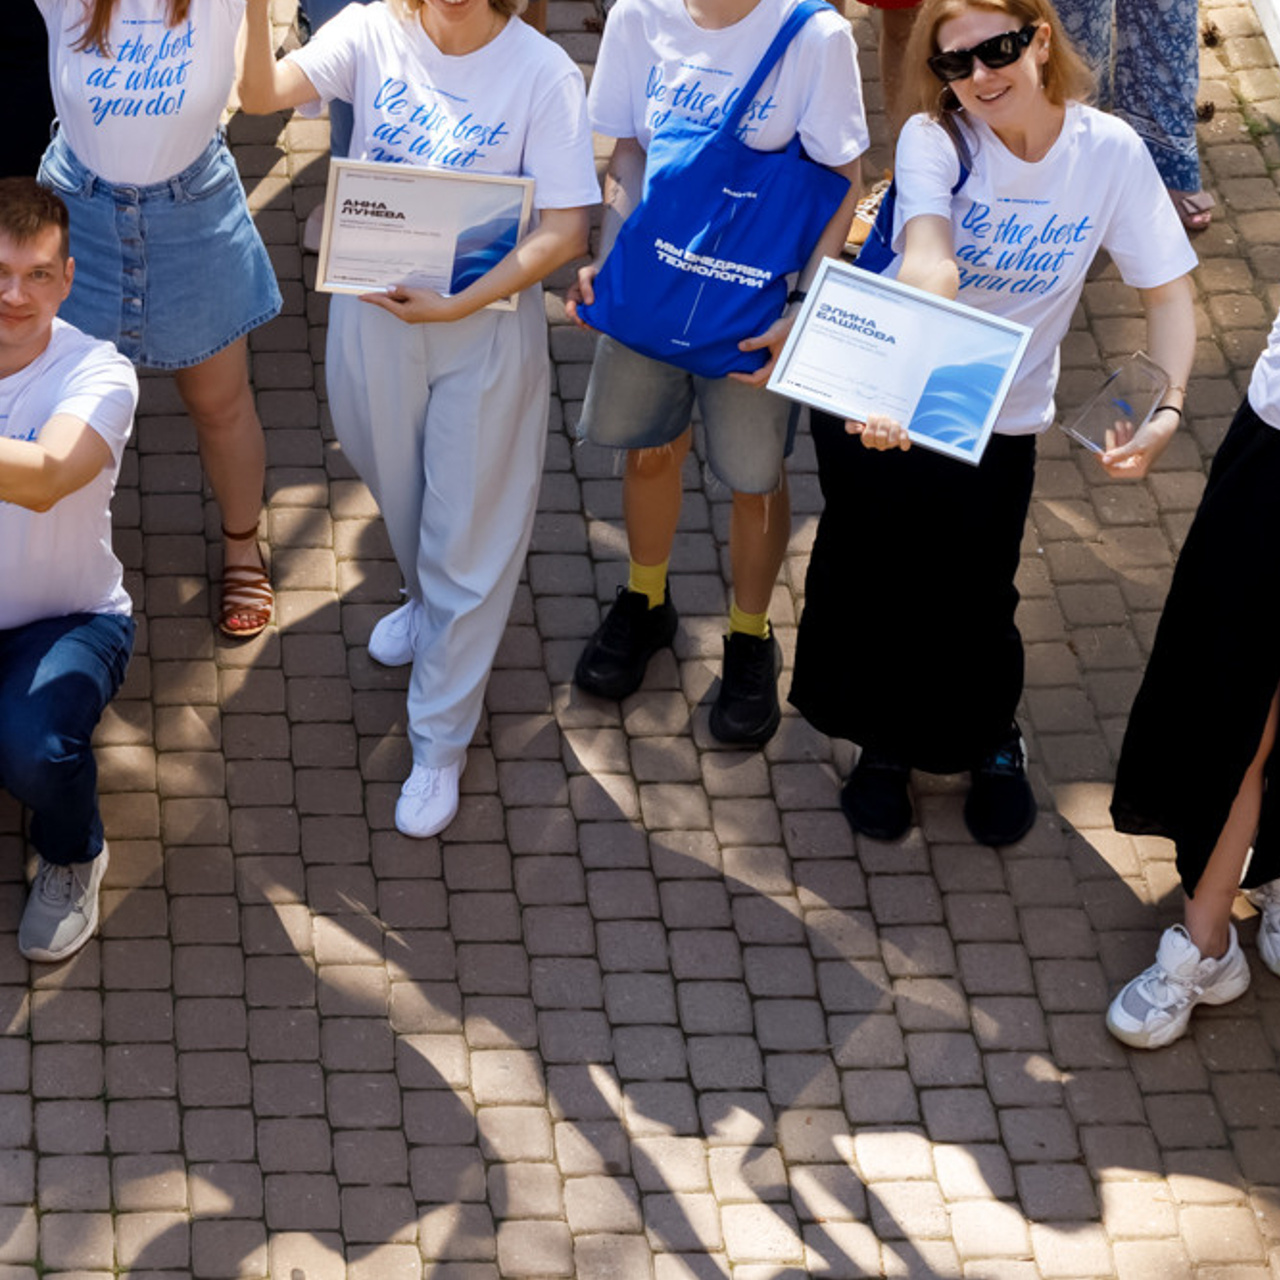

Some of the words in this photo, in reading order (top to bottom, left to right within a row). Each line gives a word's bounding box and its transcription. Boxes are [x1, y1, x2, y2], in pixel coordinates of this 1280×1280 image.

[116, 34, 153, 65] the
[86, 65, 121, 89] at
[124, 53, 193, 91] what
[88, 95, 144, 127] you
[144, 89, 186, 116] do!
[672, 81, 717, 113] the
[372, 122, 410, 145] at
[452, 112, 509, 146] best
[341, 206, 406, 220] ЛУНЕВА
[342, 198, 387, 210] АННА
[992, 213, 1034, 244] the
[1040, 213, 1094, 245] best
[654, 238, 684, 258] МЫ
[683, 249, 773, 280] ВНЕДРЯЕМ
[656, 249, 764, 289] ТЕХНОЛОГИИ
[955, 244, 993, 267] at
[995, 235, 1075, 272] what
[1009, 273, 1059, 294] do!
[815, 310, 896, 344] БАШКОВА
[819, 302, 877, 328] ЭЛИНА
